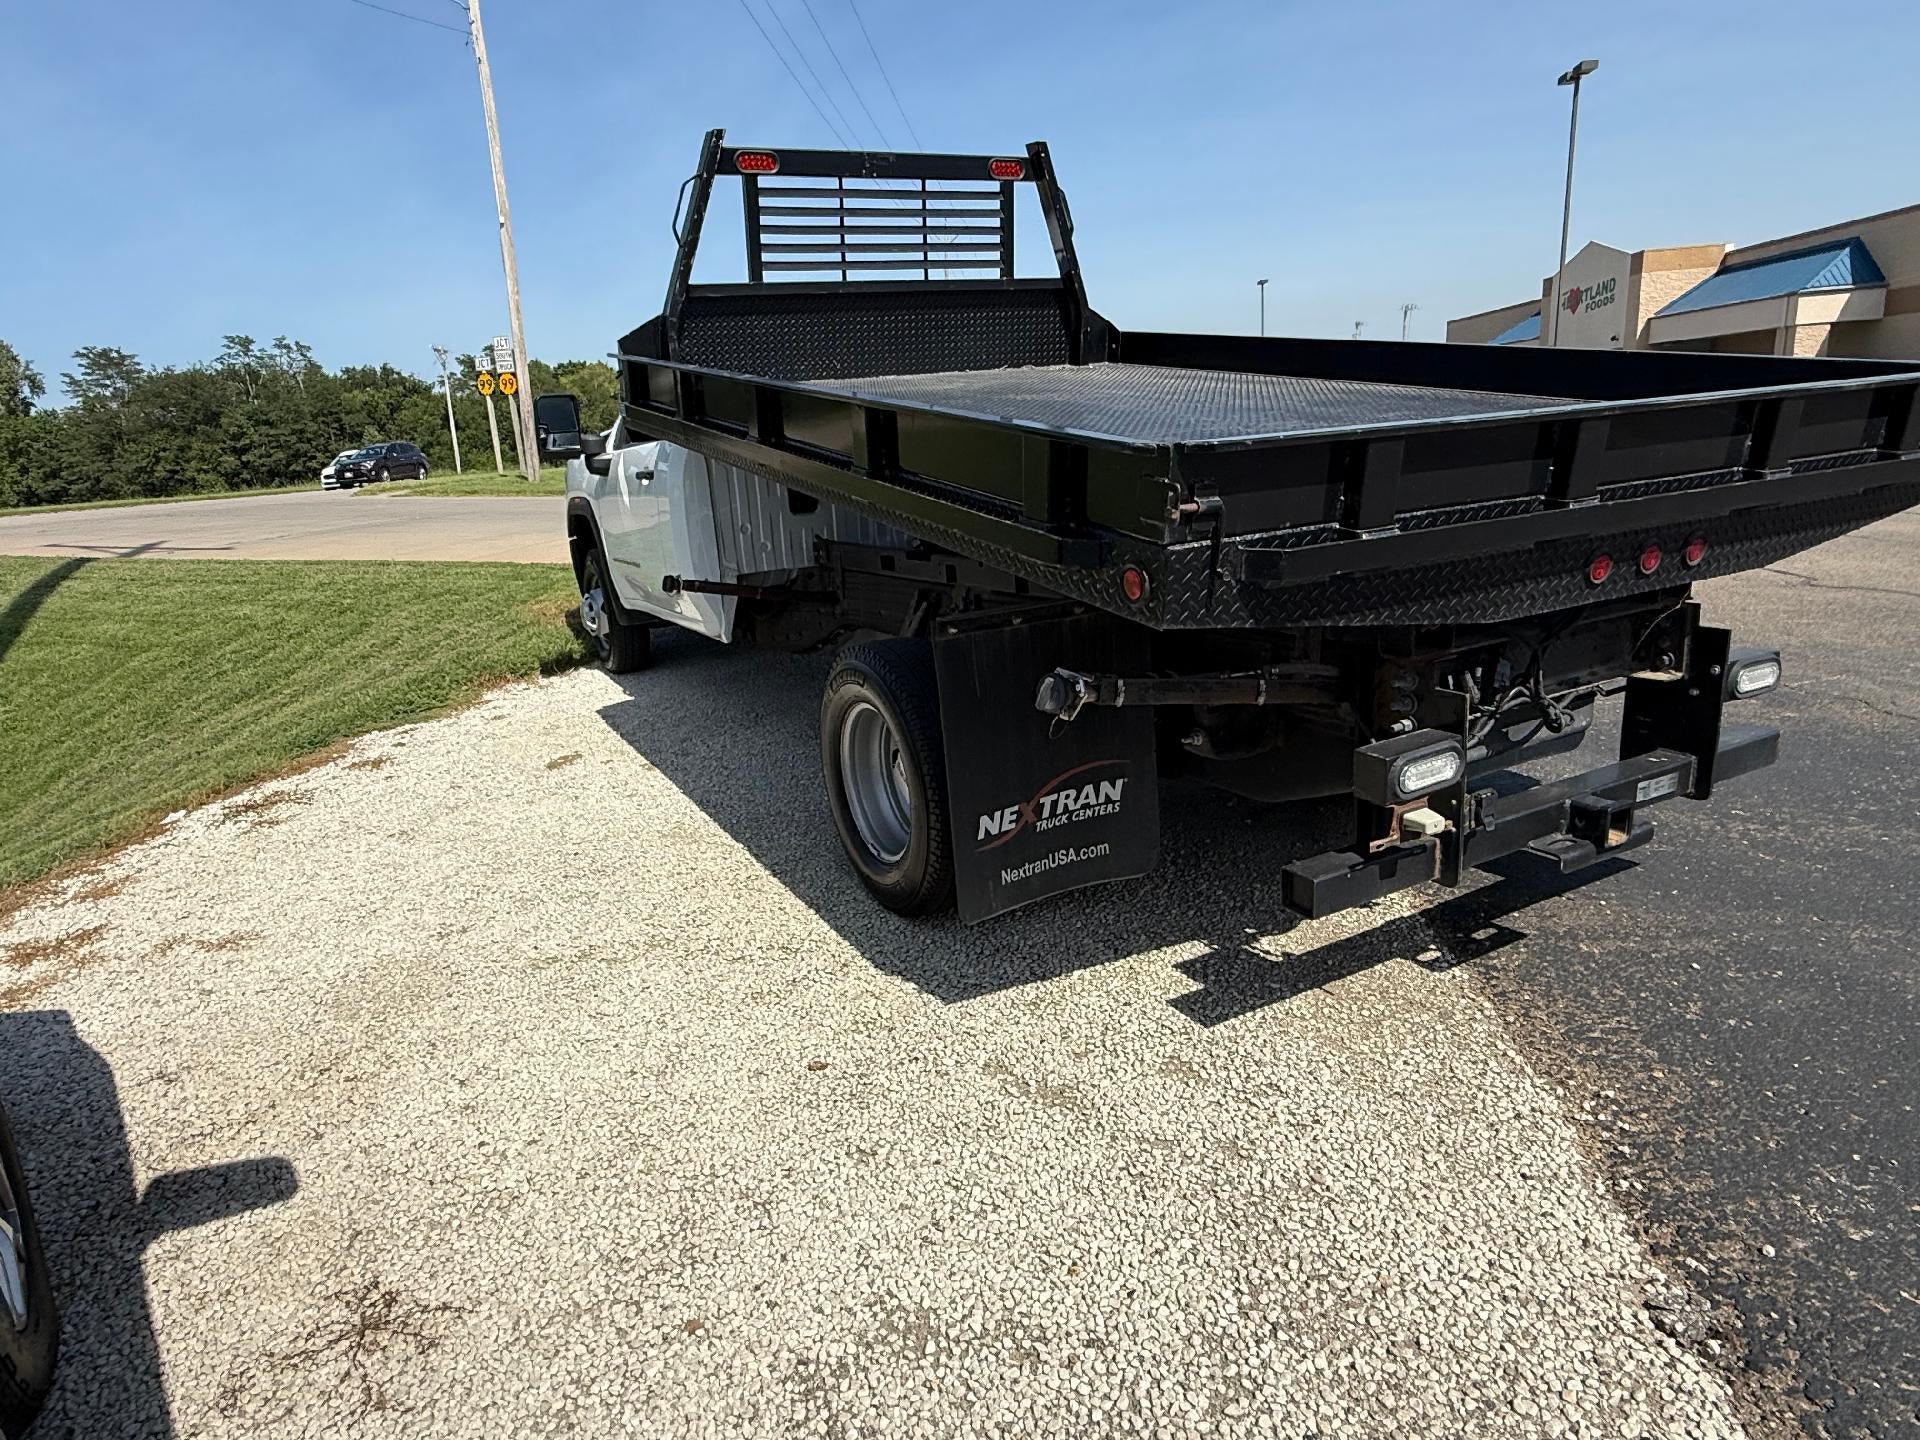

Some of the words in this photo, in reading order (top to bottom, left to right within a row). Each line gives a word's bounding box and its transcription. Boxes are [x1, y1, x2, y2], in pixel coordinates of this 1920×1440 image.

[1585, 293, 1615, 313] FOODS
[496, 338, 508, 348] JCT
[496, 352, 512, 360] SOUTH
[477, 358, 490, 369] JCT
[479, 378, 493, 391] 99
[501, 378, 514, 390] 99
[977, 778, 1124, 841] NEXTRAN
[1036, 814, 1071, 832] TRUCK
[1072, 802, 1121, 822] CENTERS
[1001, 842, 1110, 886] NextranUSA.com
